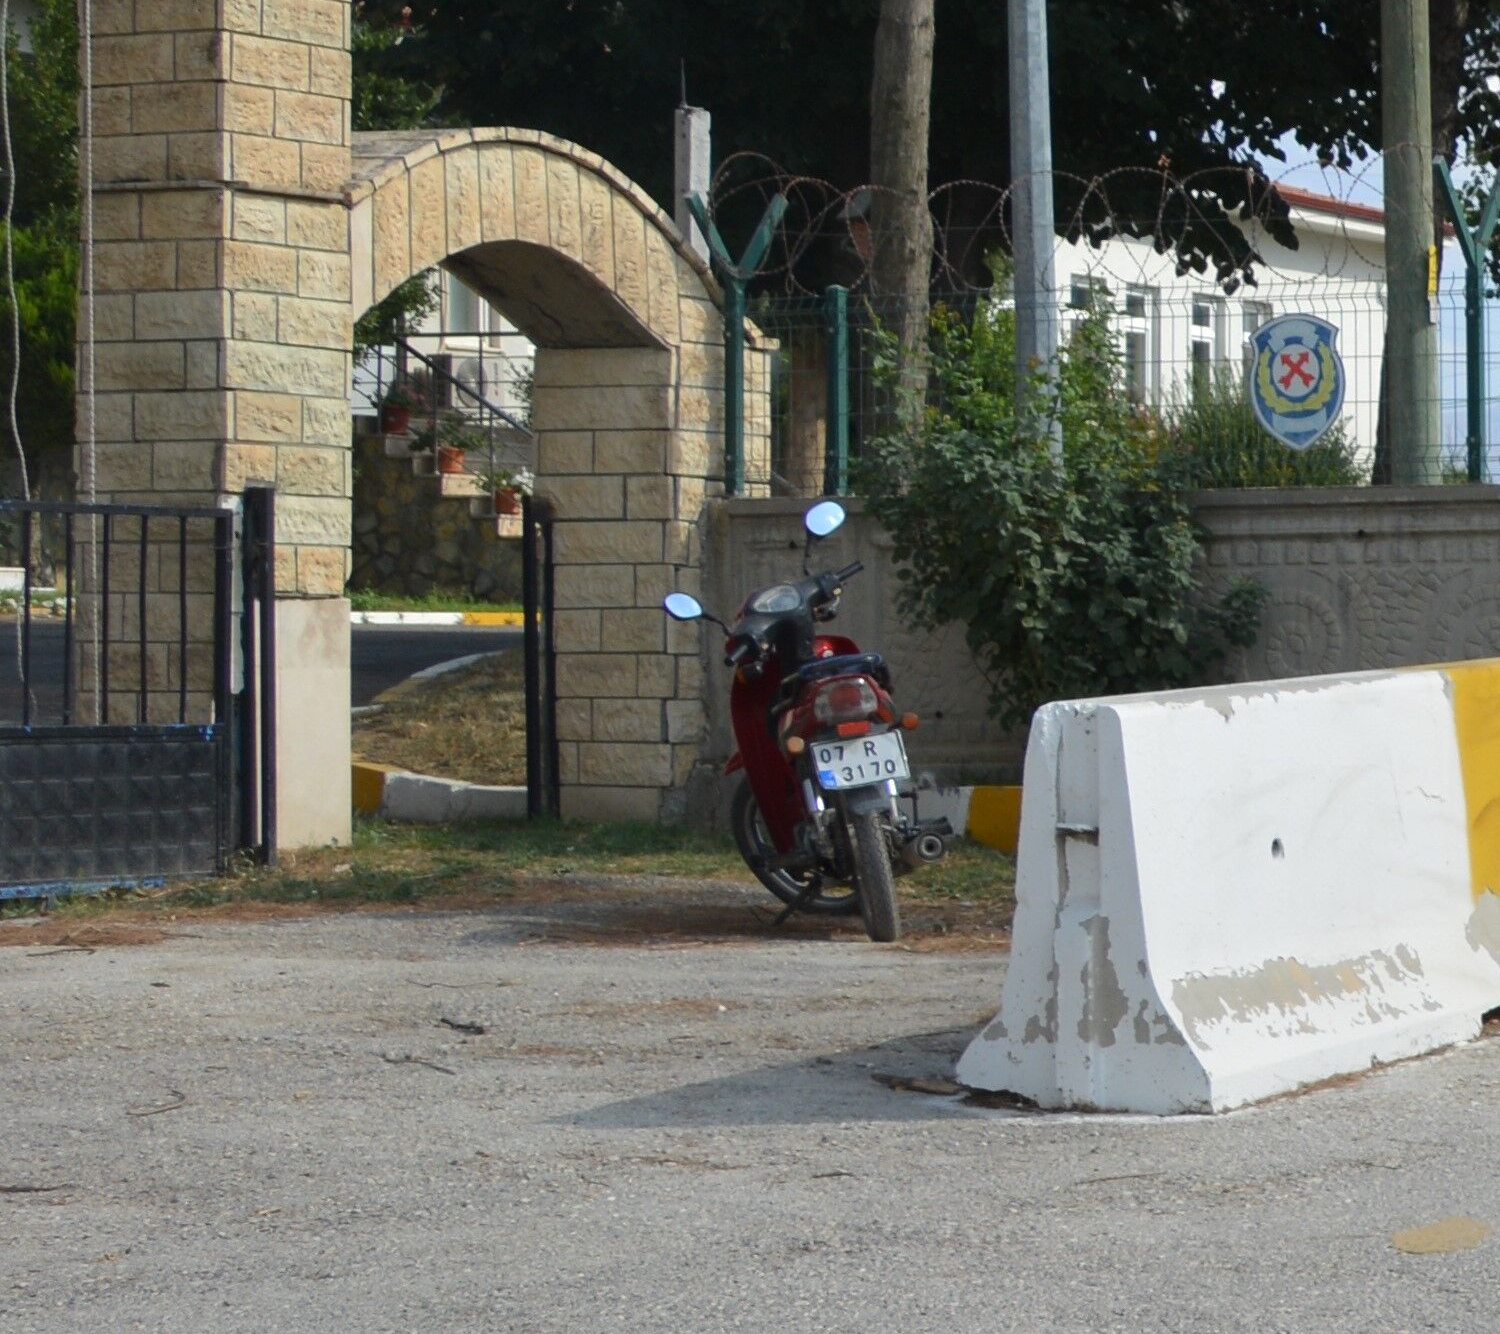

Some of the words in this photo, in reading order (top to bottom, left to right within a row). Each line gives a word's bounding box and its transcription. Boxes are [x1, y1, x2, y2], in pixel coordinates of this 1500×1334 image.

[820, 746, 845, 763] 07
[863, 740, 878, 757] R
[842, 759, 896, 782] 3170
